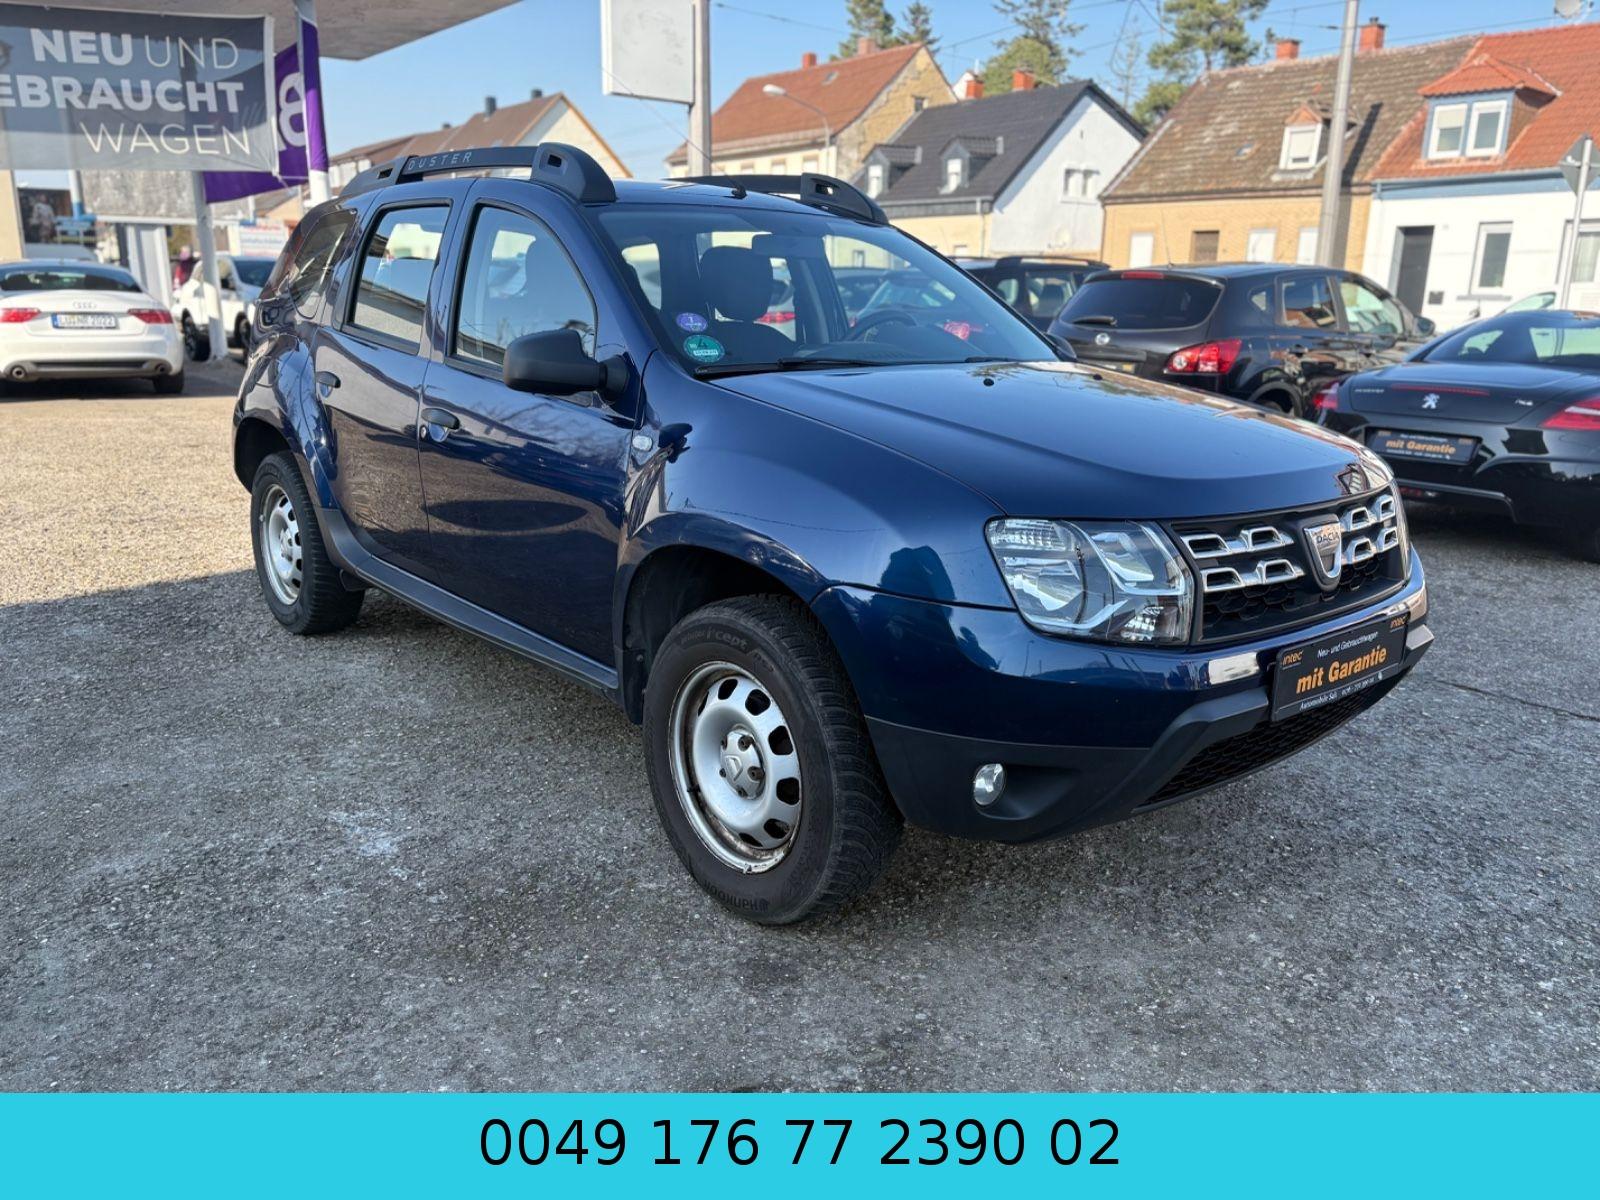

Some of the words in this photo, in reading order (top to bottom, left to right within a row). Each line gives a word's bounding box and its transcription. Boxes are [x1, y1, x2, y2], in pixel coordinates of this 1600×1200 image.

[31, 28, 133, 66] NEU
[145, 35, 239, 69] UND
[80, 122, 252, 156] WAGEN
[407, 151, 473, 171] DUSTER
[1406, 440, 1457, 454] Garantie
[1295, 666, 1325, 694] mit
[1328, 644, 1388, 682] Garantie
